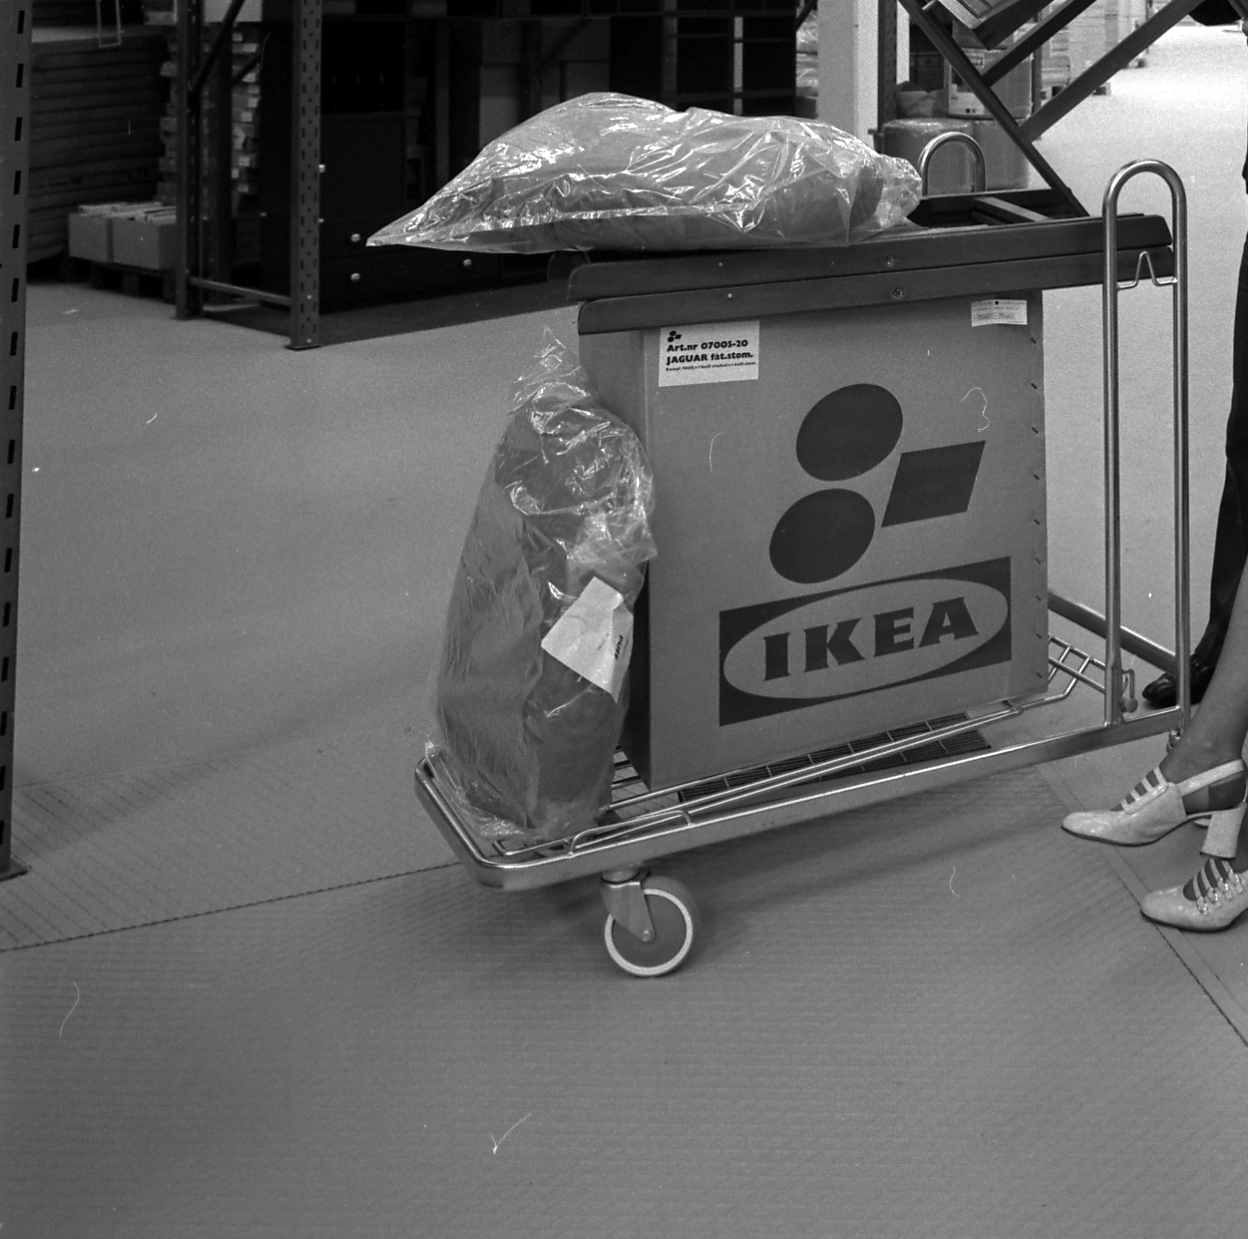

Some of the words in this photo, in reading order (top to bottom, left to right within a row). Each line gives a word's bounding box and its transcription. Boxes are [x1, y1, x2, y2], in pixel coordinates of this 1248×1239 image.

[667, 343, 698, 352] Art.nr
[700, 339, 749, 350] 07005-20
[666, 353, 708, 366] JAGUAR
[763, 596, 980, 682] IKEA
